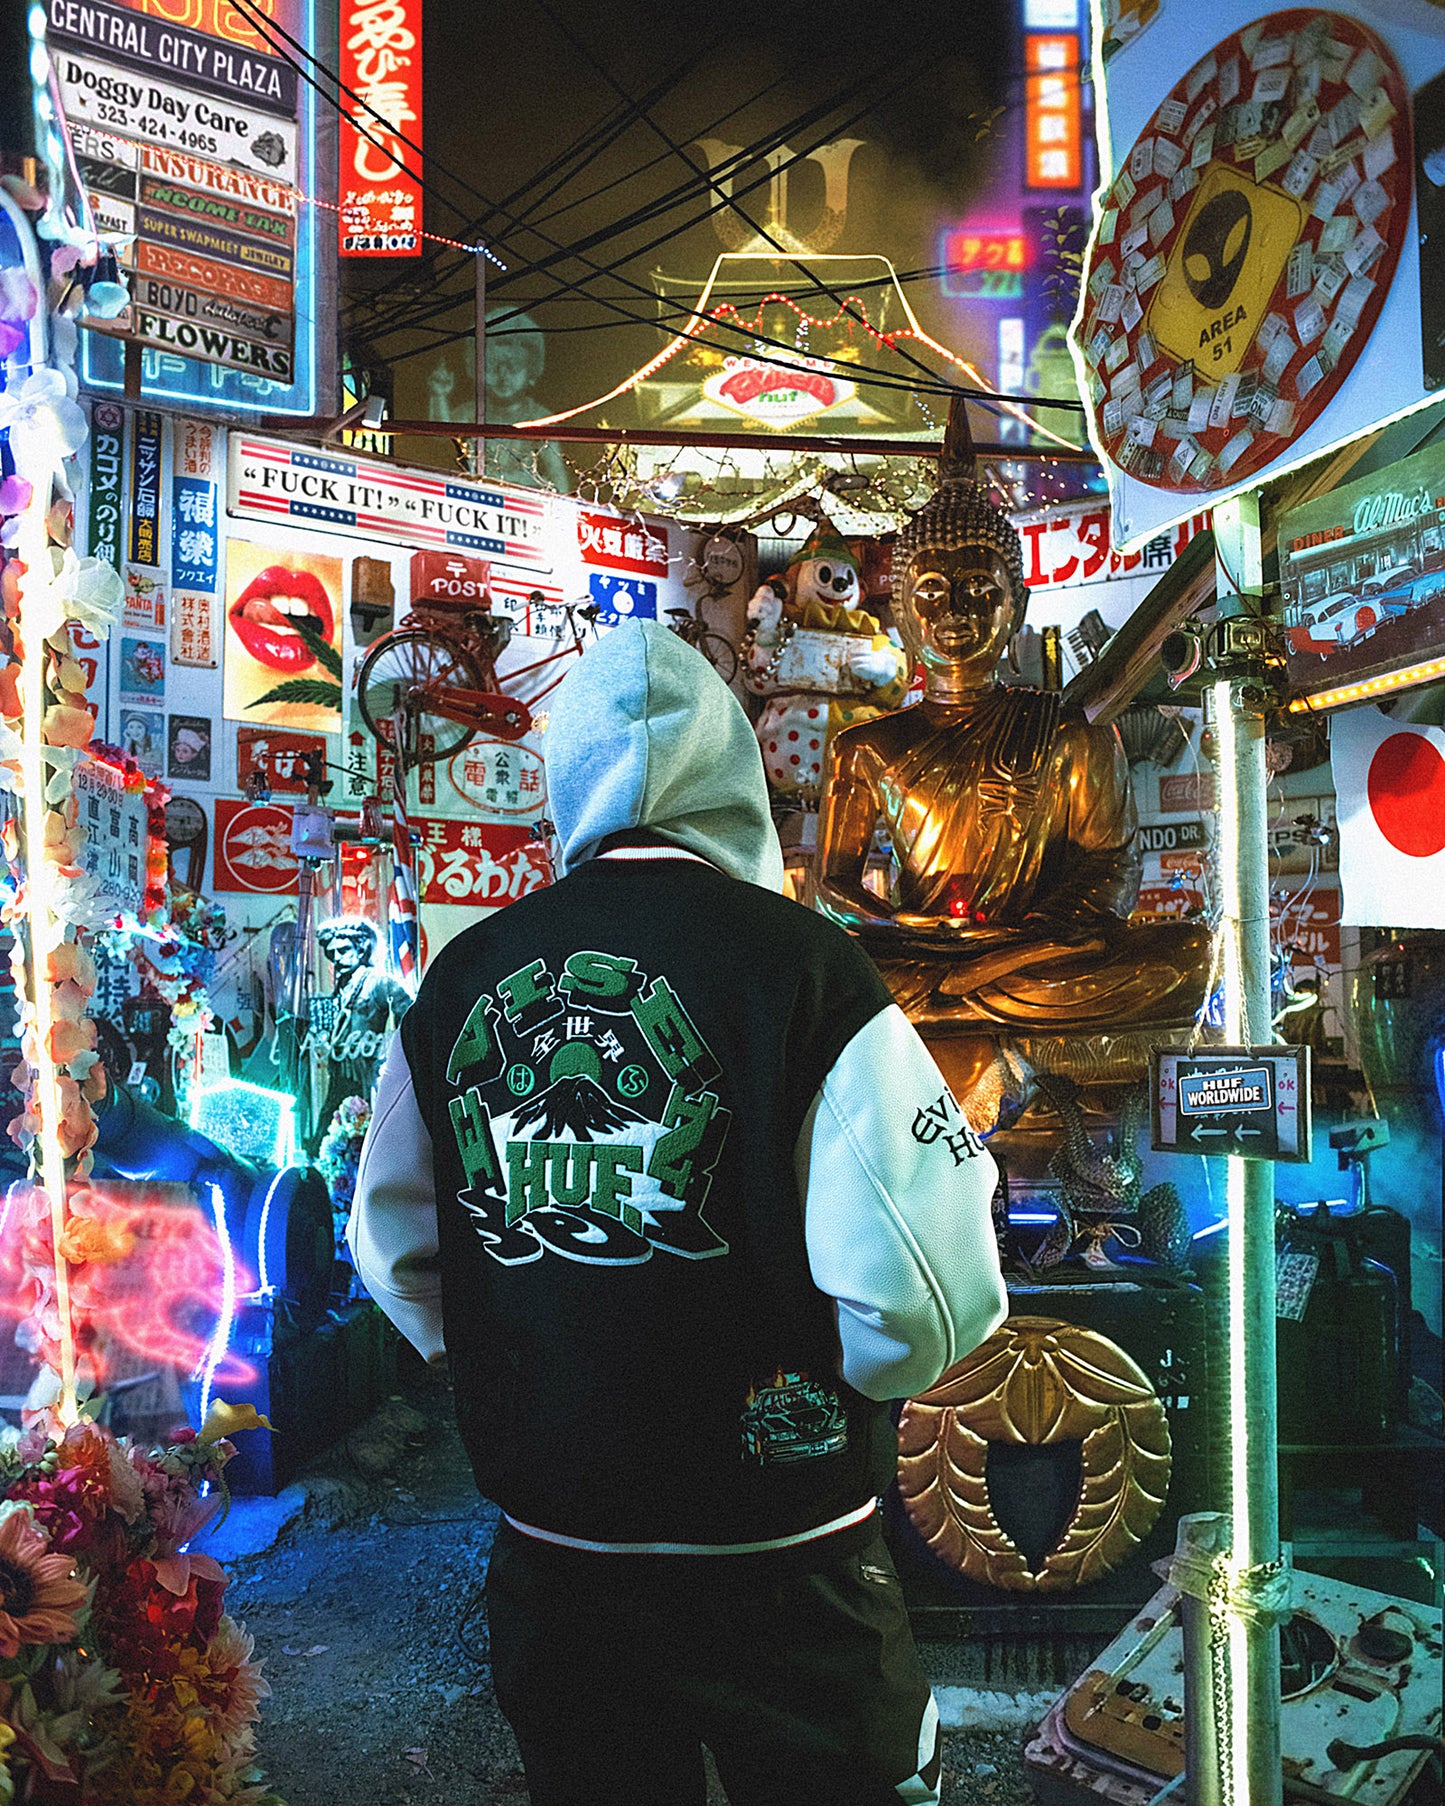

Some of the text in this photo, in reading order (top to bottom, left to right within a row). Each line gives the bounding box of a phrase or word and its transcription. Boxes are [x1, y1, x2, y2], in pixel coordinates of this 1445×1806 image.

[50, 0, 152, 58] CENTRAL
[159, 33, 209, 73] CITY
[213, 51, 283, 99] PLAZA
[65, 61, 250, 138] Doggy Day Care
[97, 103, 218, 154] 323-424-4965
[142, 146, 294, 212] INSURANCE
[143, 217, 178, 240] SUPER
[180, 228, 239, 255] SWAPMEET
[244, 212, 288, 239] TAX
[147, 281, 198, 316] BOYD
[139, 312, 290, 375] FLOWERS
[1199, 307, 1248, 349] AREA
[1212, 341, 1233, 363] 51
[1293, 525, 1345, 552] DINER
[430, 577, 489, 598] POST
[530, 1015, 625, 1066] 全世界
[1187, 1085, 1262, 1108] WORLDWIDE
[1202, 1077, 1244, 1091] HUF
[503, 1140, 645, 1238] HUF
